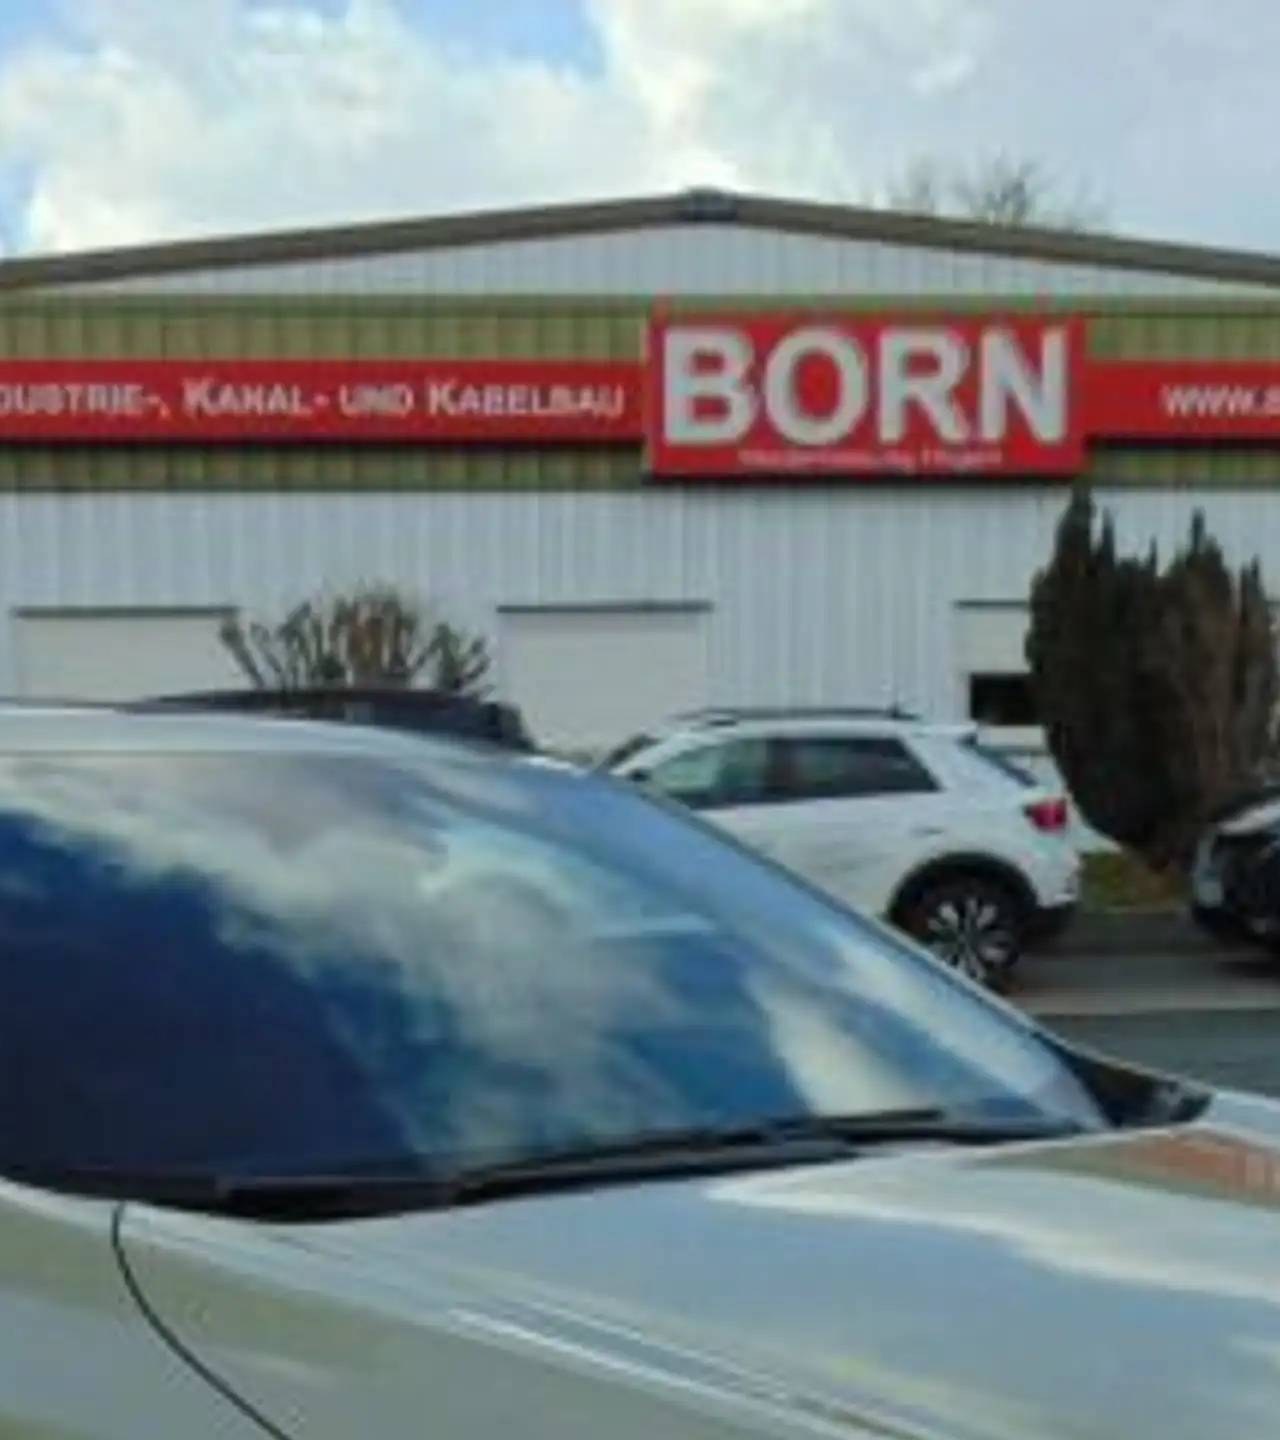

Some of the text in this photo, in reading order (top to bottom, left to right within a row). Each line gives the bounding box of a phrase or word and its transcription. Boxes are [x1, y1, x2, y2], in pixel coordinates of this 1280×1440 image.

[338, 381, 414, 418] UND
[426, 378, 625, 419] KABELBAU
[663, 327, 1067, 446] BORN
